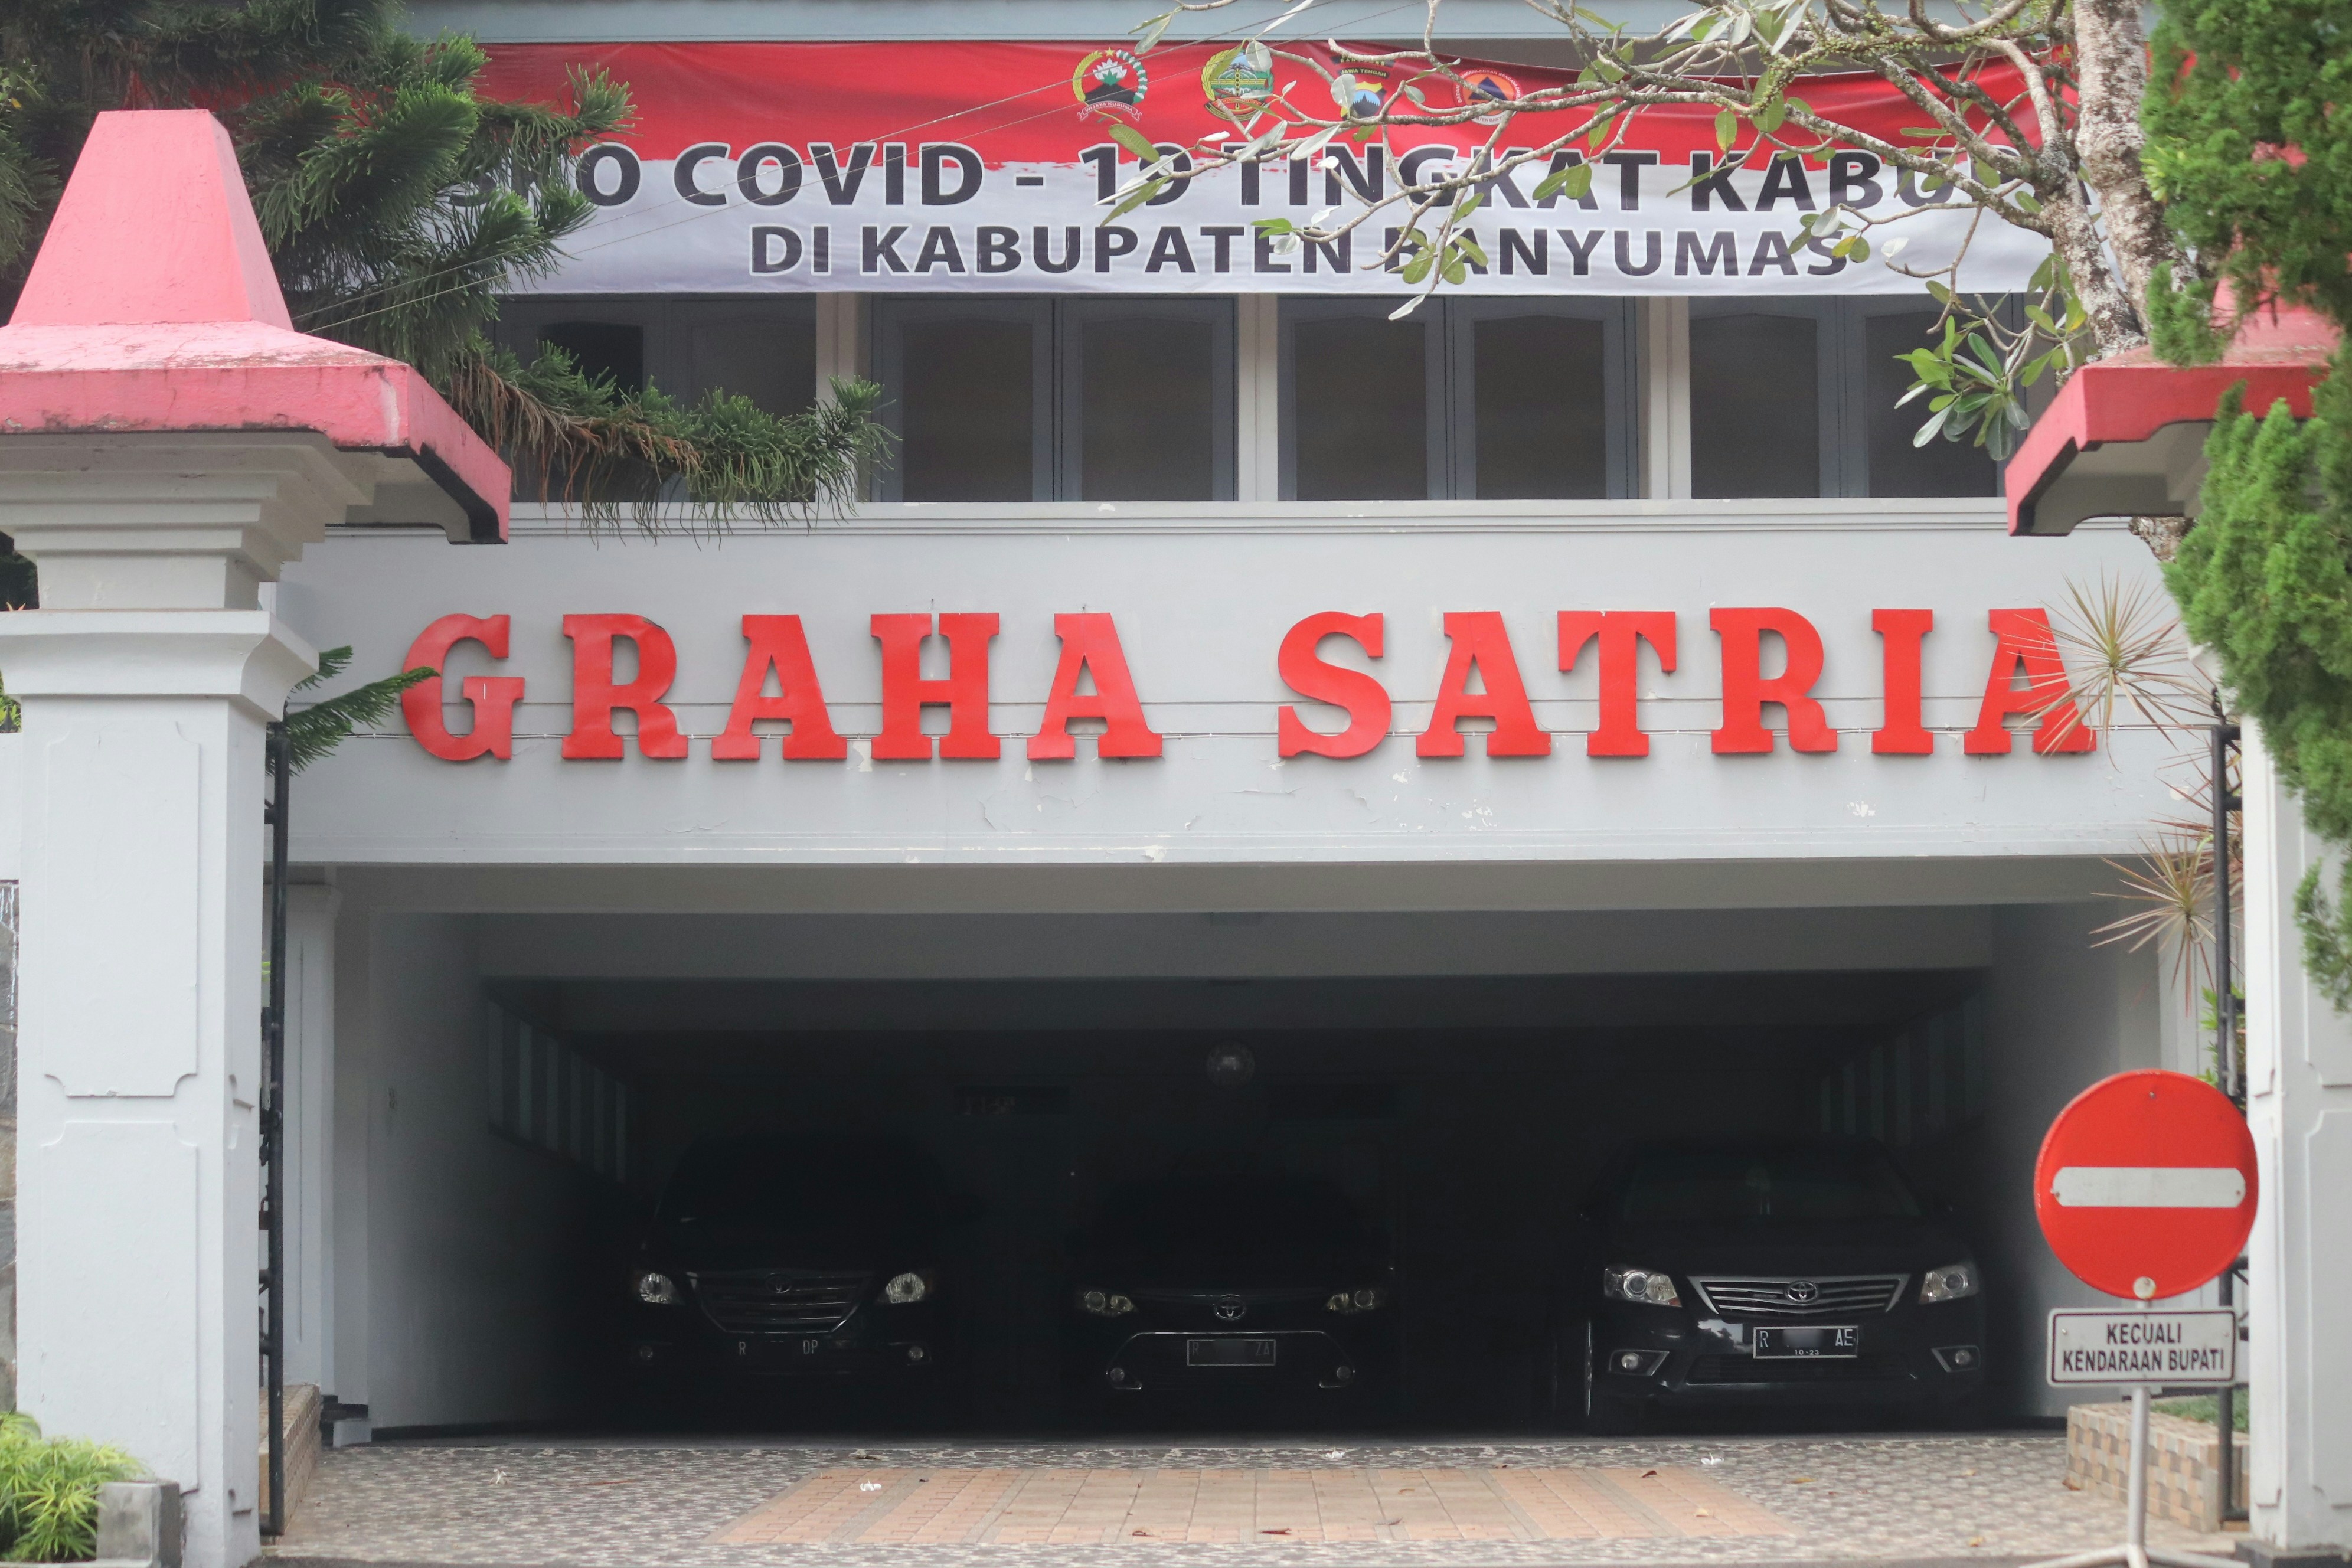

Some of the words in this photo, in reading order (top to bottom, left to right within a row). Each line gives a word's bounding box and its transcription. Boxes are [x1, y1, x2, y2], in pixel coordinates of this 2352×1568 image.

[1360, 68, 1387, 77] TENGAH
[1084, 102, 1107, 112] WIJAYA
[1108, 102, 1133, 112] KUSUMA
[672, 143, 984, 207] COVID
[1080, 145, 1193, 207] 19
[1221, 145, 1657, 211] TINGKAT
[752, 226, 829, 273] DI
[861, 226, 1351, 273] KABUPATEN
[1384, 227, 1847, 276] BANYUMAS
[401, 613, 1163, 760] GRAHA
[1278, 607, 2097, 760] SATRIA
[1760, 1330, 1769, 1348] R
[1835, 1329, 1853, 1347] AE
[2106, 1323, 2181, 1345] KECUALI
[739, 1341, 746, 1355] R
[803, 1340, 819, 1354] DP
[2063, 1350, 2162, 1371] KENDARAAN
[2168, 1349, 2224, 1370] BUPATI
